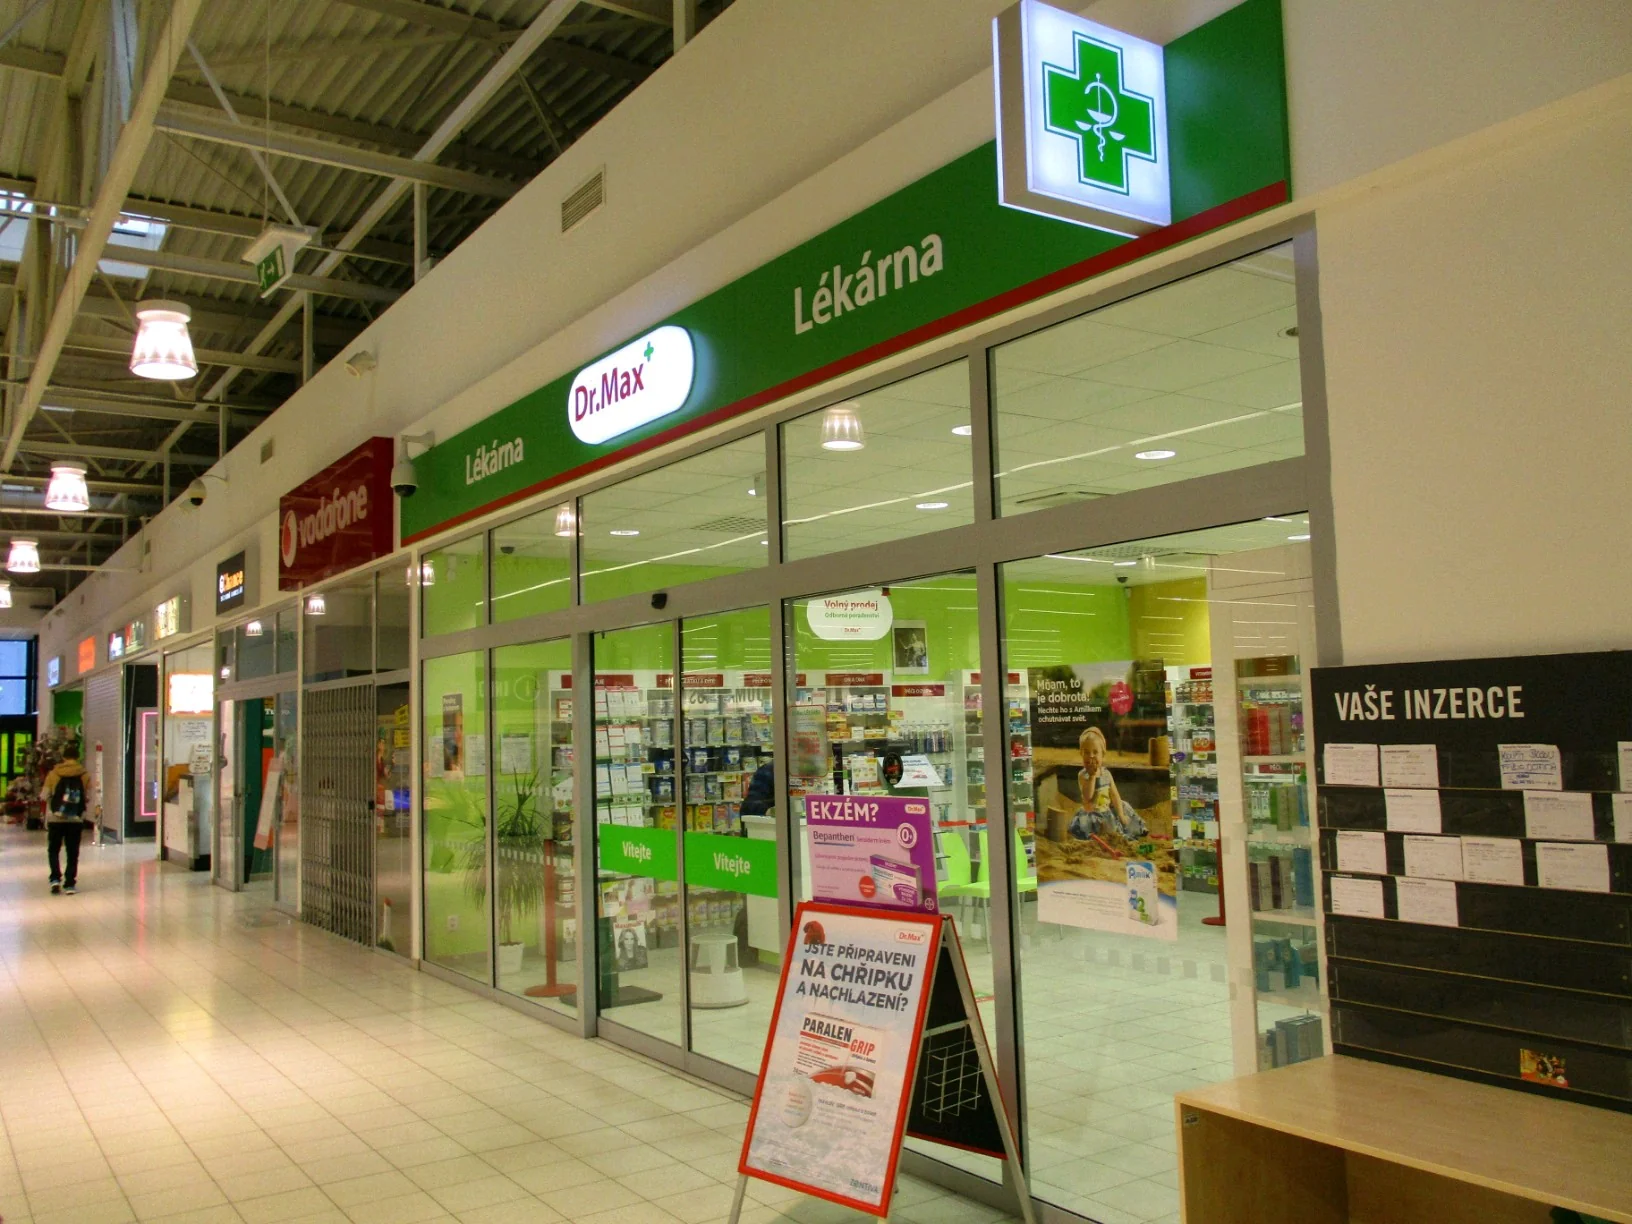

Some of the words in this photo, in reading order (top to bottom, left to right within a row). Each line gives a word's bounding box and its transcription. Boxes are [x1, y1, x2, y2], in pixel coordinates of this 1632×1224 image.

[794, 232, 944, 335] Lékárna
[574, 360, 646, 423] Dr.Max
[465, 434, 524, 486] Lékárna
[300, 484, 368, 548] vodafone
[824, 600, 849, 611] Volný
[850, 600, 878, 611] prodej
[1070, 679, 1081, 689] to
[1037, 693, 1046, 705] je
[1048, 691, 1090, 703] dobrota!
[1335, 684, 1395, 721] VAŠE
[1405, 685, 1525, 720] INZERCE
[1038, 715, 1071, 723] ochutnávat
[810, 798, 879, 822] EKZÉM?
[813, 830, 855, 842] Bepanthen
[622, 840, 652, 862] Vítejte
[713, 851, 751, 877] Vítejte
[898, 931, 922, 942] Dr.Max
[804, 943, 834, 957] JSTE
[837, 942, 916, 968] PŘIPRAVENI
[800, 959, 826, 979] NA
[830, 958, 913, 992] CHŘIPKU
[796, 983, 806, 996] A
[809, 983, 909, 1012] NACHLAZENÍ?
[803, 1017, 852, 1043] PARALEN
[850, 1039, 876, 1056] GRIP
